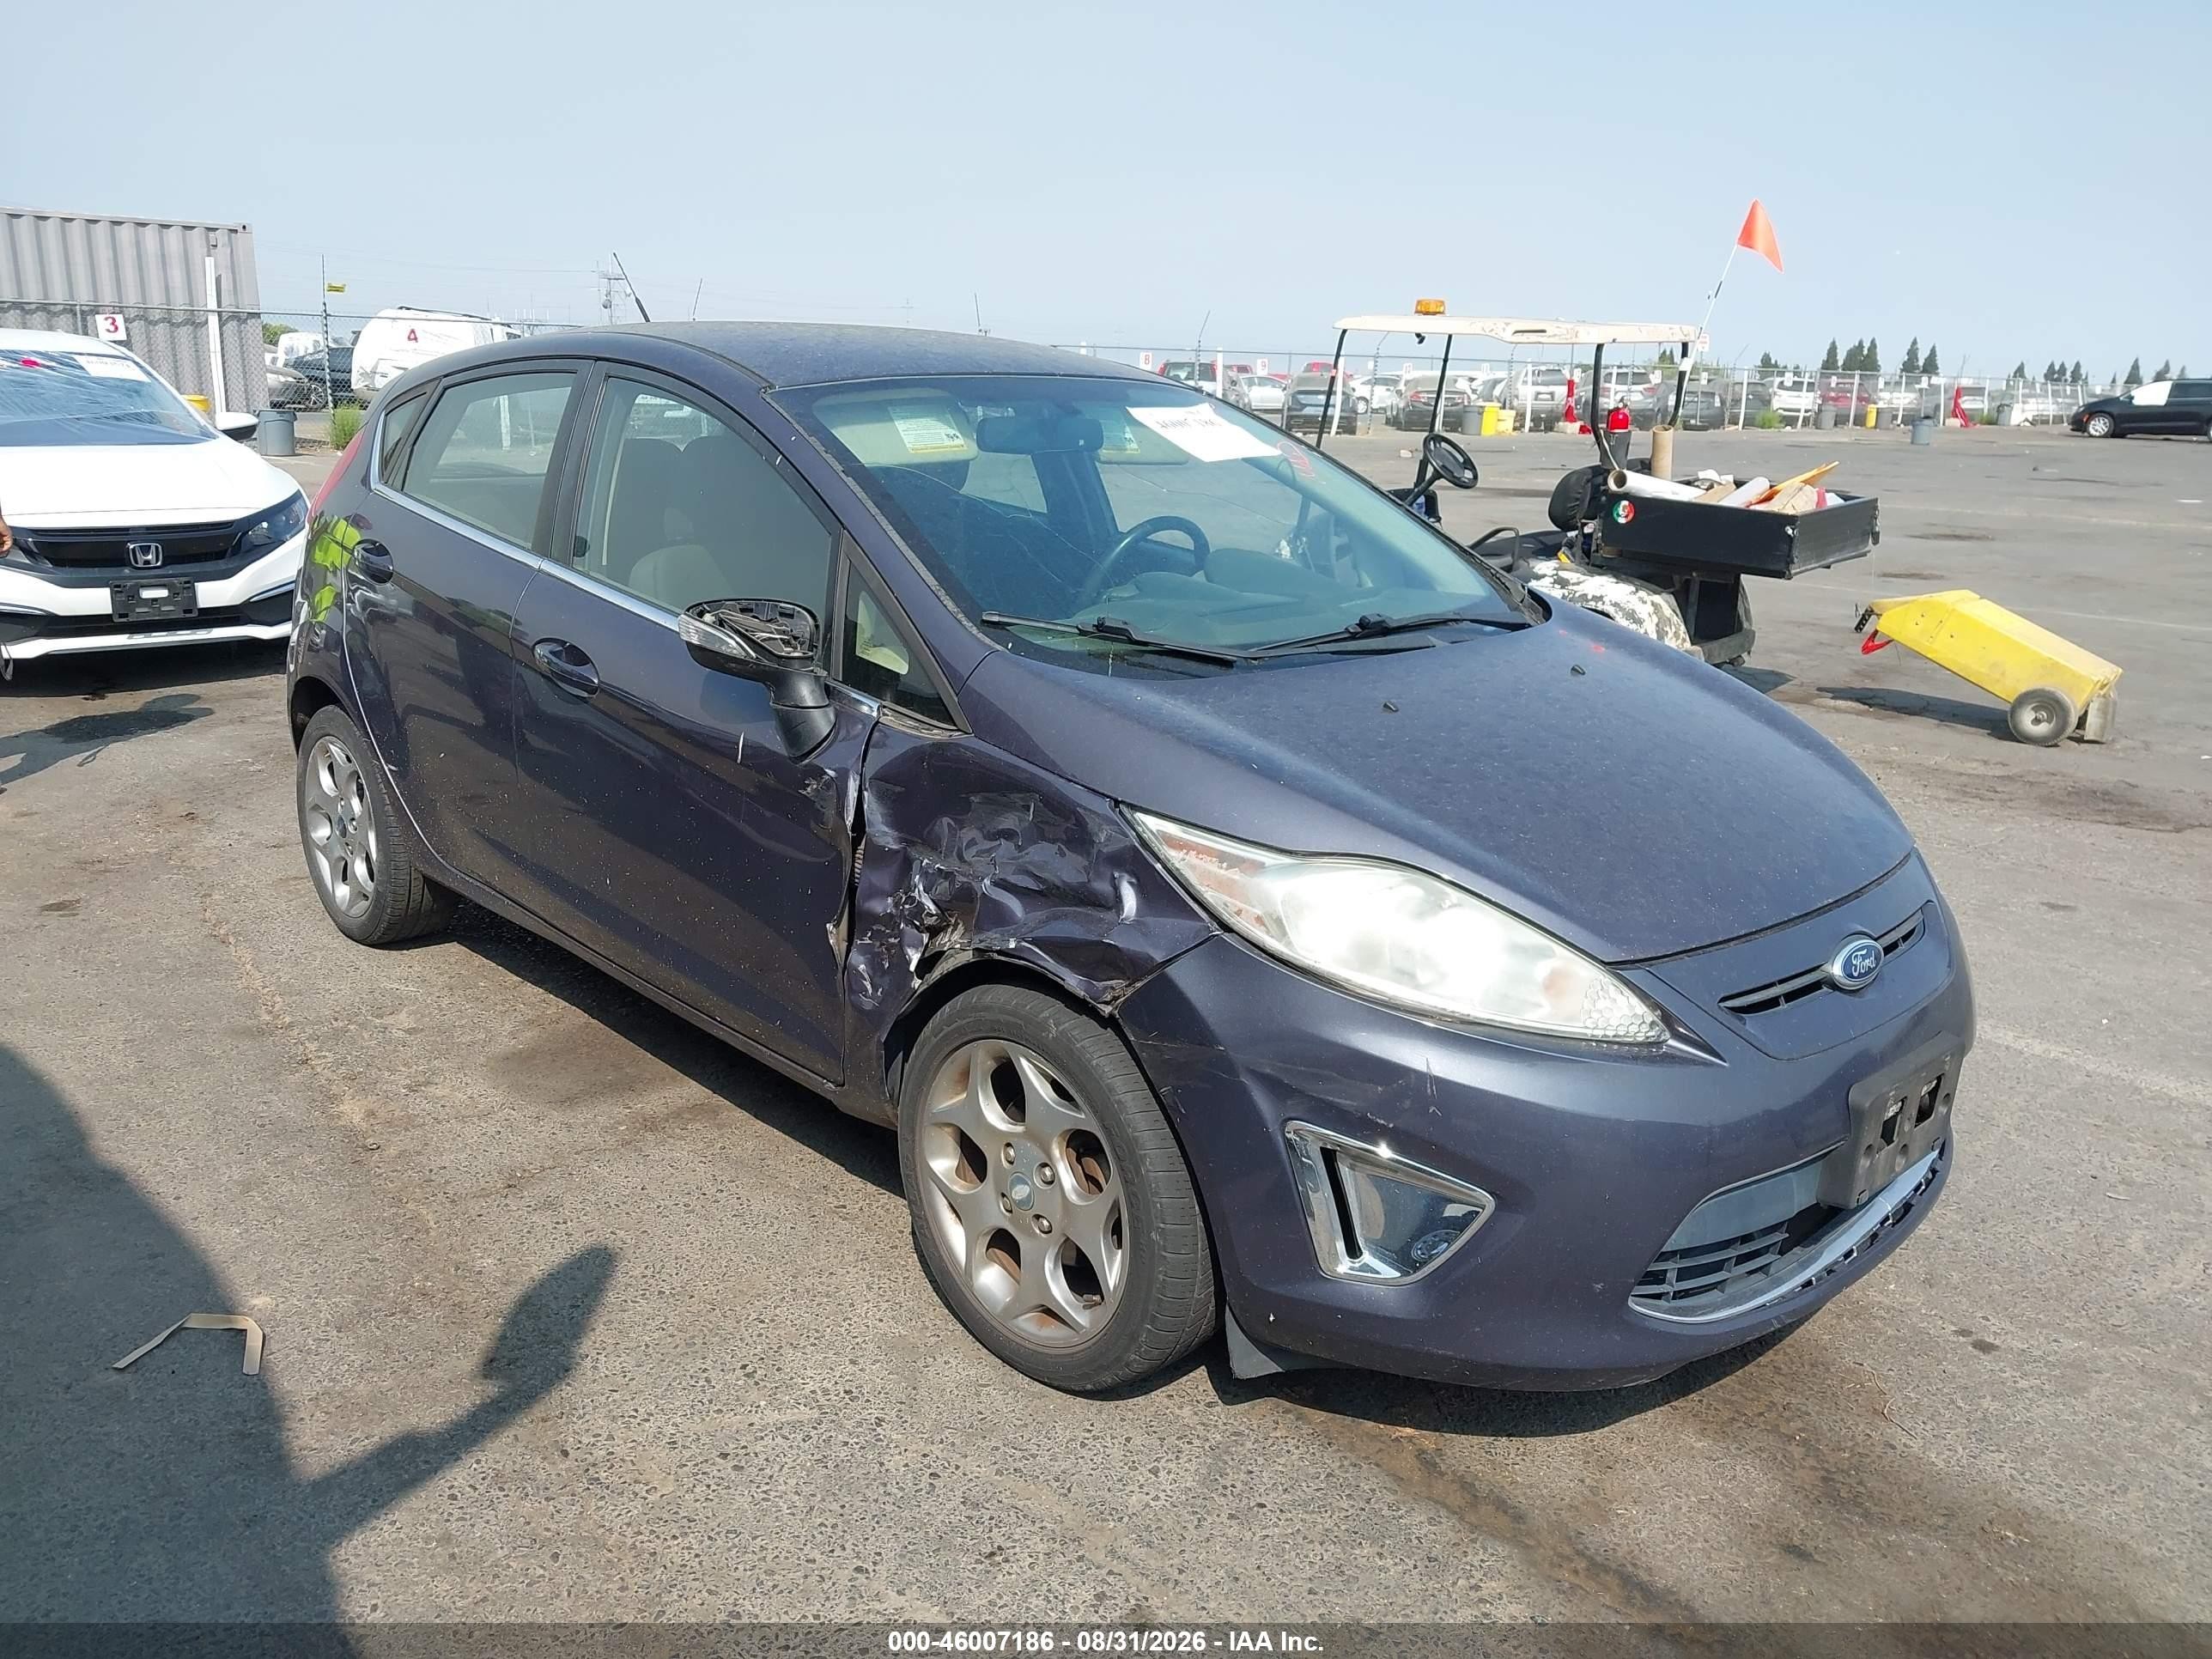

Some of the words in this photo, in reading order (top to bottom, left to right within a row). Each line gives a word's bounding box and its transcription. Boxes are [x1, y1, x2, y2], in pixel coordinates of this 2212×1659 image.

[104, 316, 118, 333] 3
[407, 328, 419, 343] 4
[1851, 948, 1877, 977] Ford
